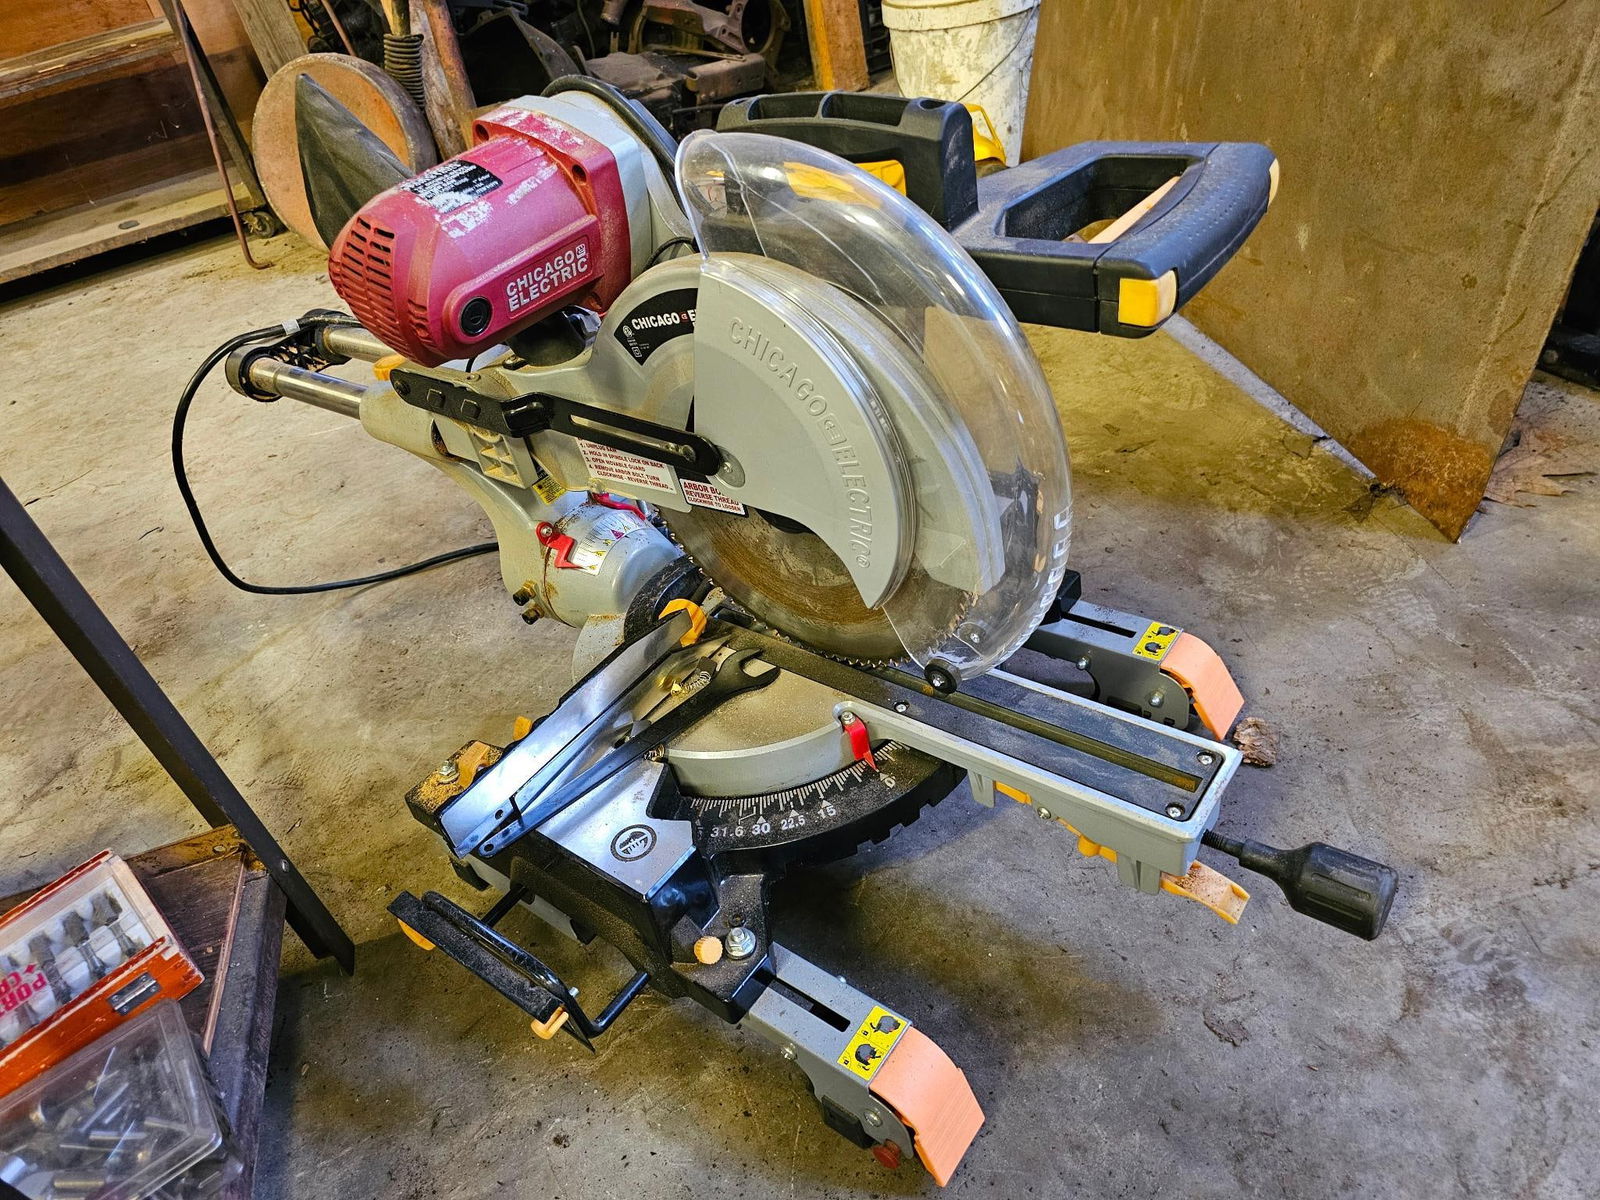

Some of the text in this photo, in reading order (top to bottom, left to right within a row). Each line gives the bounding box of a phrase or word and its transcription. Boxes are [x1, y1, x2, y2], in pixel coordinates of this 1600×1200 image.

[506, 250, 575, 298] CHICAGO
[508, 258, 588, 312] ELECTRIC
[631, 312, 680, 330] CHICAGO
[729, 316, 828, 417] CHICAGO
[605, 460, 628, 468] MOVABLE
[628, 462, 645, 471] GUARD
[608, 453, 628, 461] SPINDLE
[628, 456, 641, 464] LOCK
[594, 464, 614, 472] REMOVE
[645, 474, 660, 482] TURN
[596, 471, 624, 480] CLOCKWISE
[627, 476, 649, 485] REVERSE
[649, 480, 669, 489] THREAD
[683, 481, 710, 494] ARBOR
[685, 489, 713, 501] REVERSE
[687, 496, 713, 507] CLOCKWISE
[721, 503, 742, 512] LOOSEN
[817, 806, 837, 819] 15
[752, 822, 771, 836] 30
[781, 815, 806, 831] 22.5
[710, 826, 744, 838] 31.6
